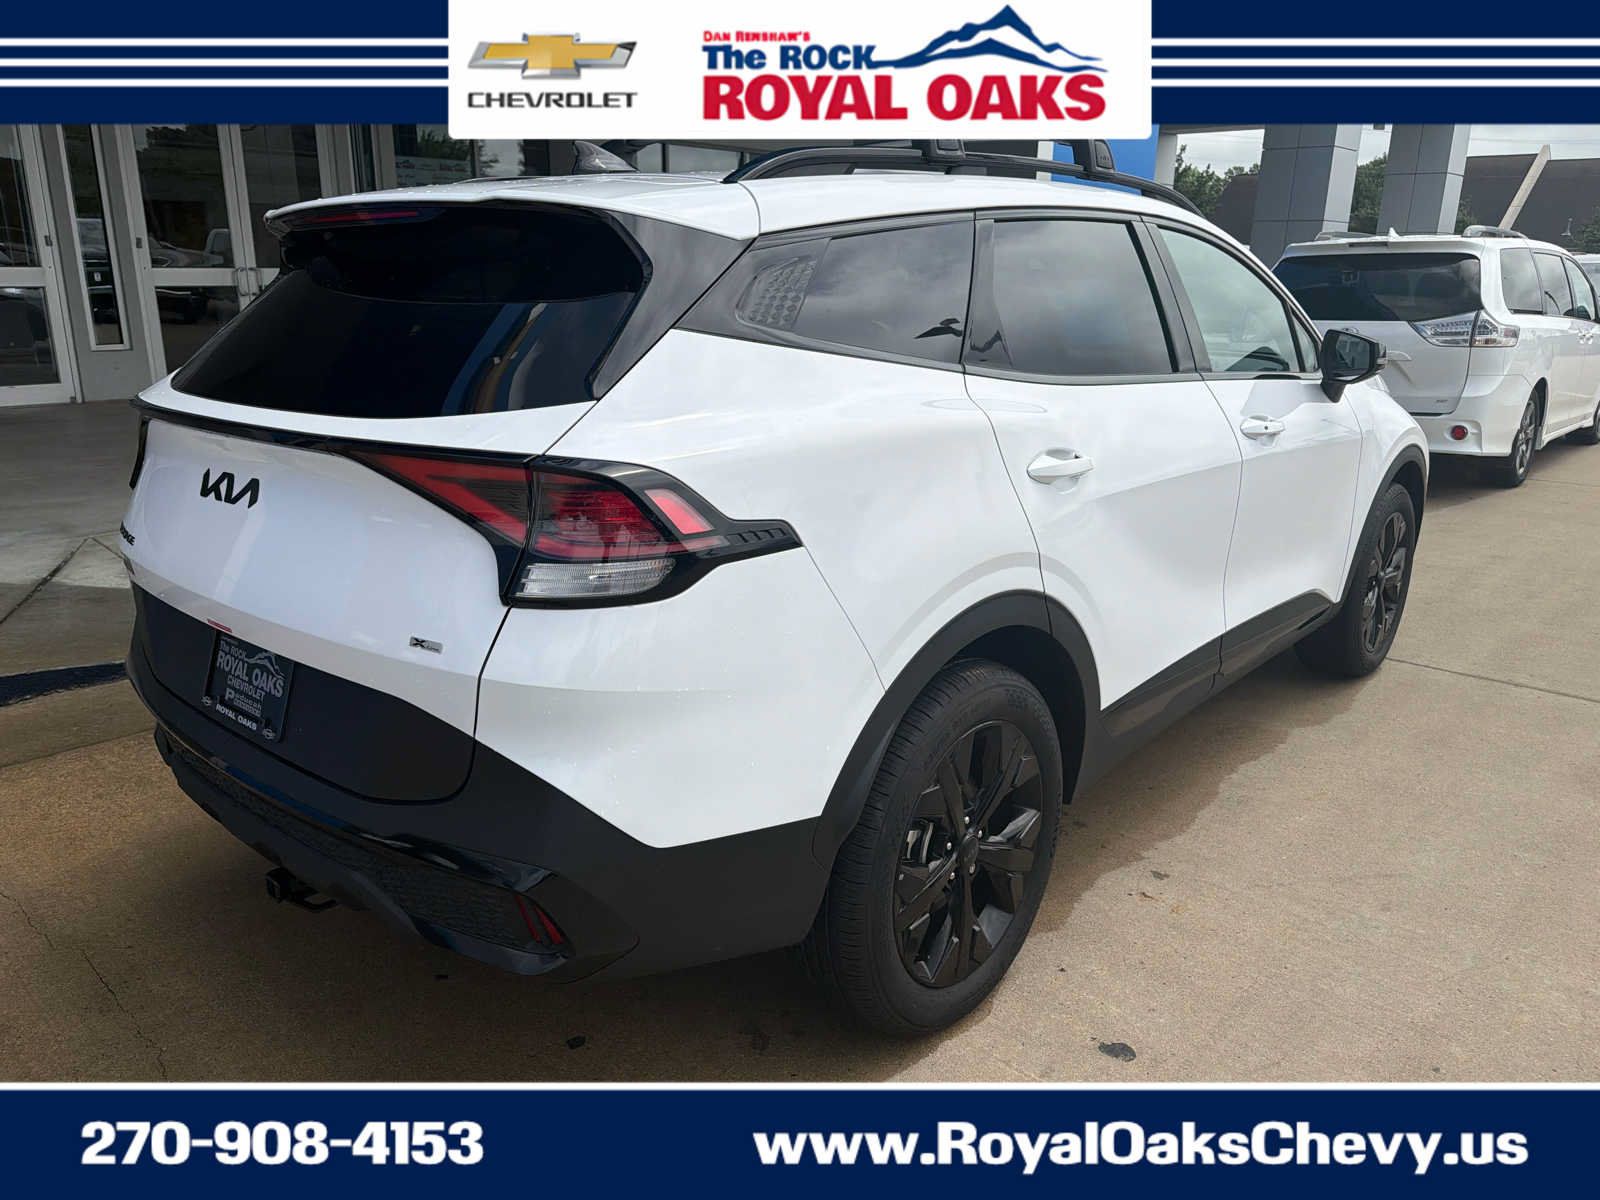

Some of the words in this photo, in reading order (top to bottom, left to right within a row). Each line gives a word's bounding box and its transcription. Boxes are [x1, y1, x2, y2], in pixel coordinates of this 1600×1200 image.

[230, 646, 248, 661] ROCK
[216, 650, 249, 682] ROYAL
[252, 669, 285, 698] OAKS
[226, 675, 266, 702] CHEVROLET
[215, 703, 237, 721] ROYAL
[237, 715, 257, 731] OAKS
